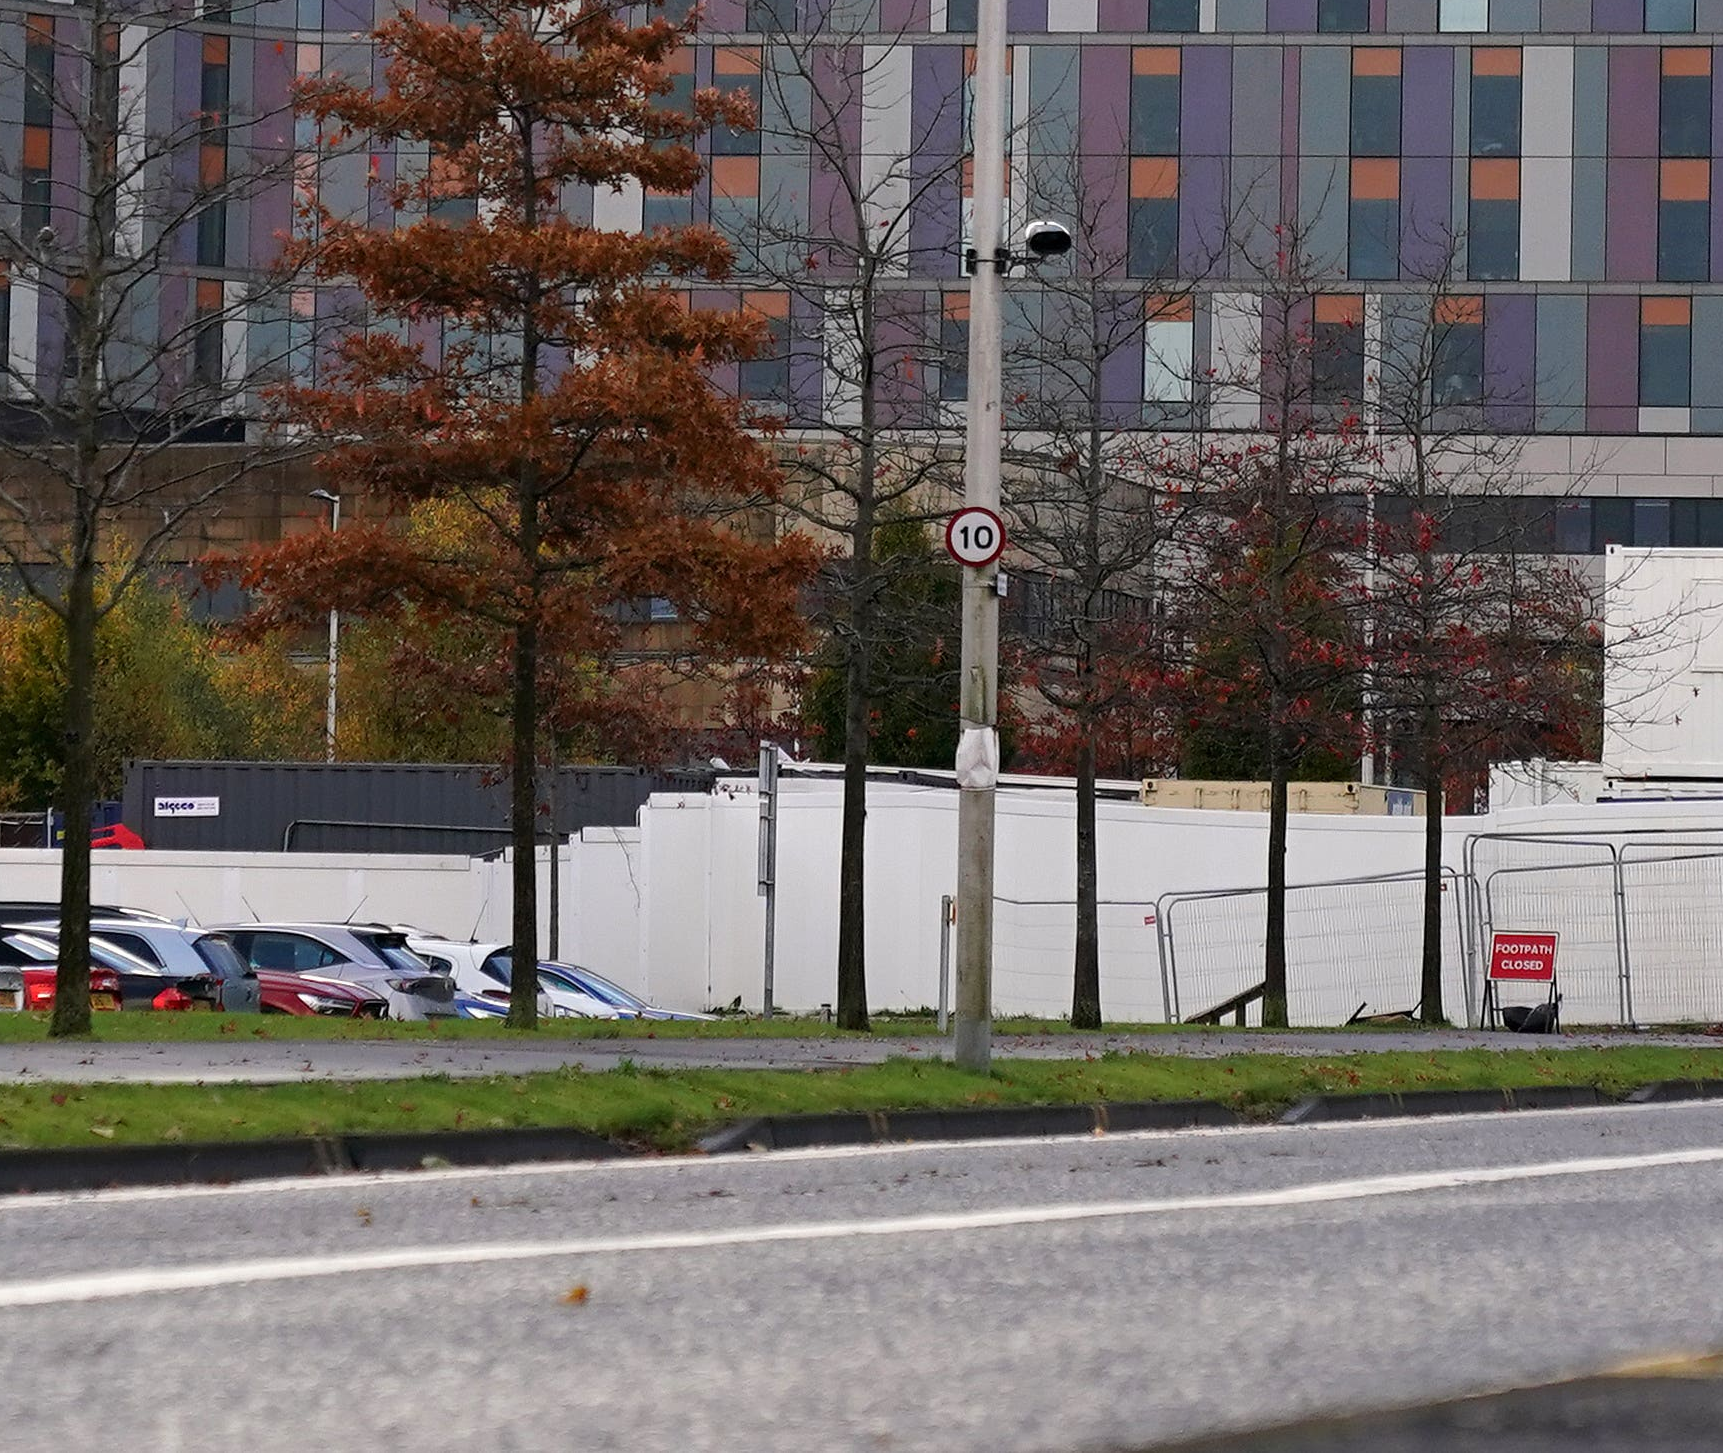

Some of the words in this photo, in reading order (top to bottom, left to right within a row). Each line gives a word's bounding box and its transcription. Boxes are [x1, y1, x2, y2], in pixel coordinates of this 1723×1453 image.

[960, 525, 993, 550] 10
[1495, 943, 1553, 955] FOOTPATH
[1501, 959, 1544, 971] CLOSED
